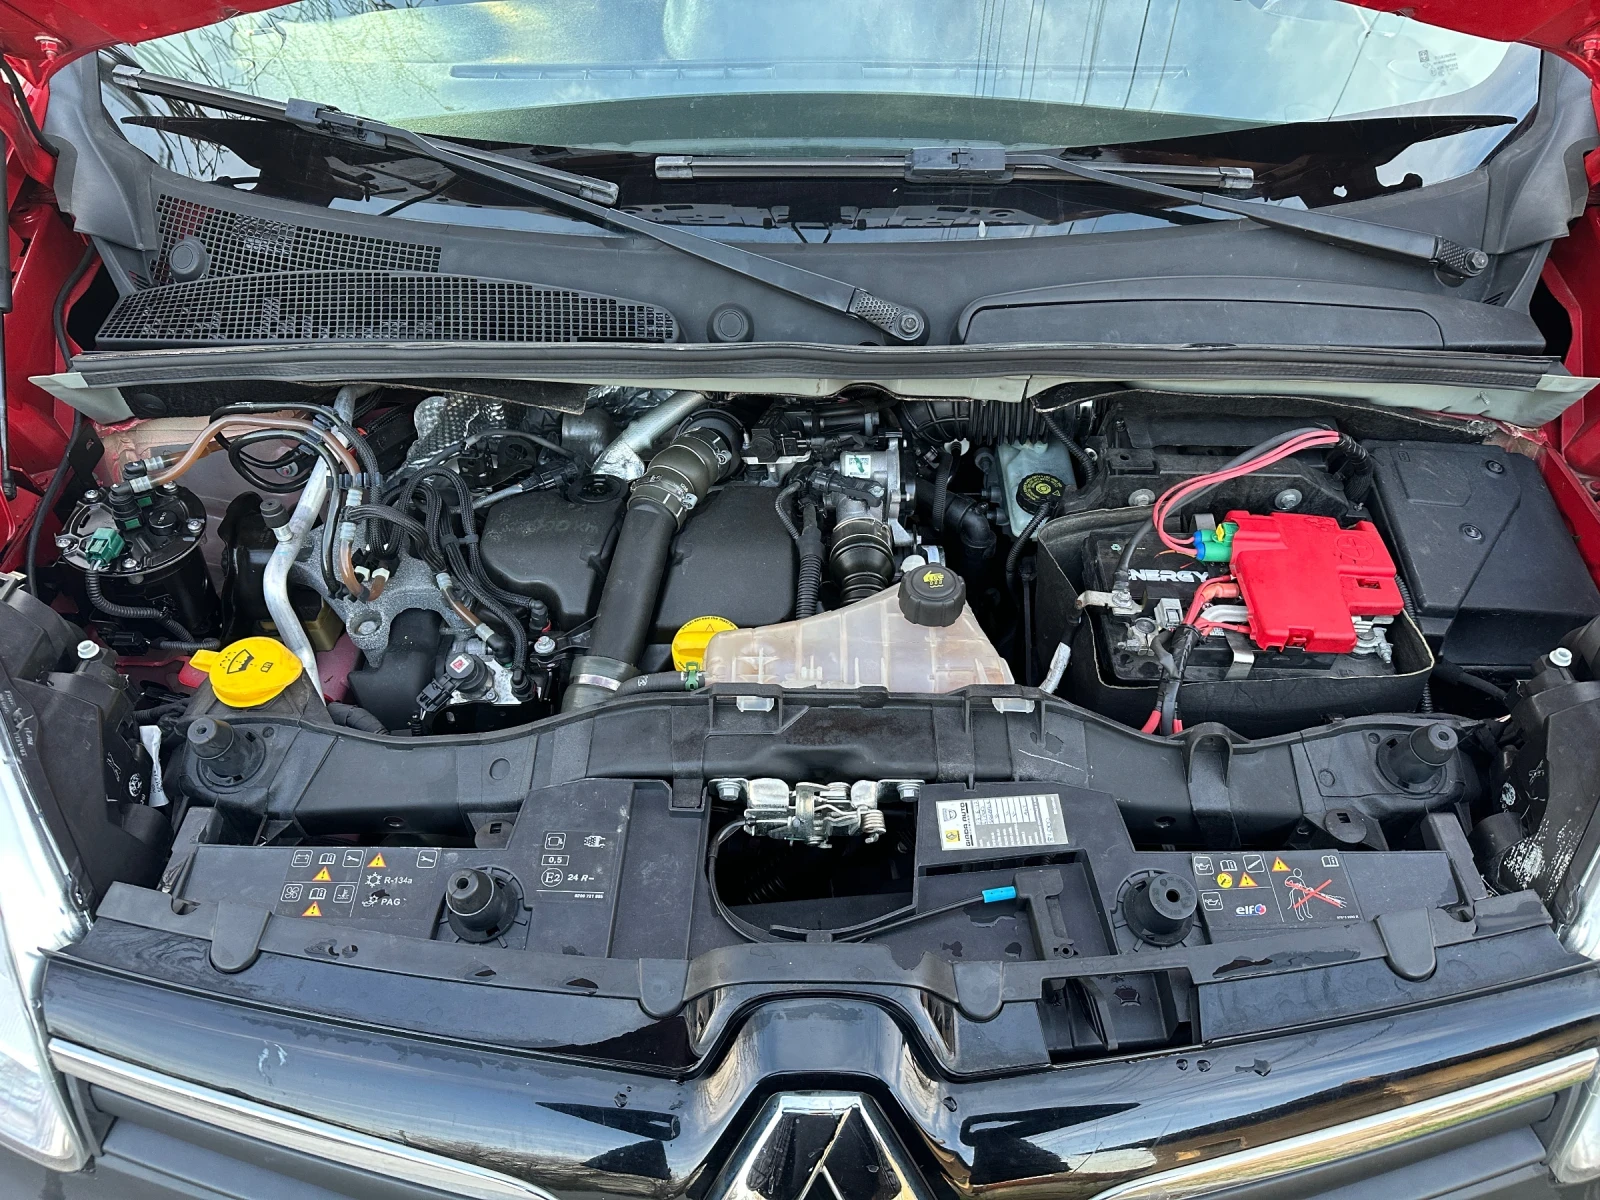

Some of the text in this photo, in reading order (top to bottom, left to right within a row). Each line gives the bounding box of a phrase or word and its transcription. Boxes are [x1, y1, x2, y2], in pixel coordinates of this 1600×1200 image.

[1128, 568, 1209, 583] NERGY
[383, 876, 413, 884] R-134a
[567, 873, 579, 881] 24
[380, 898, 401, 906] PAG
[1235, 905, 1255, 915] elf
